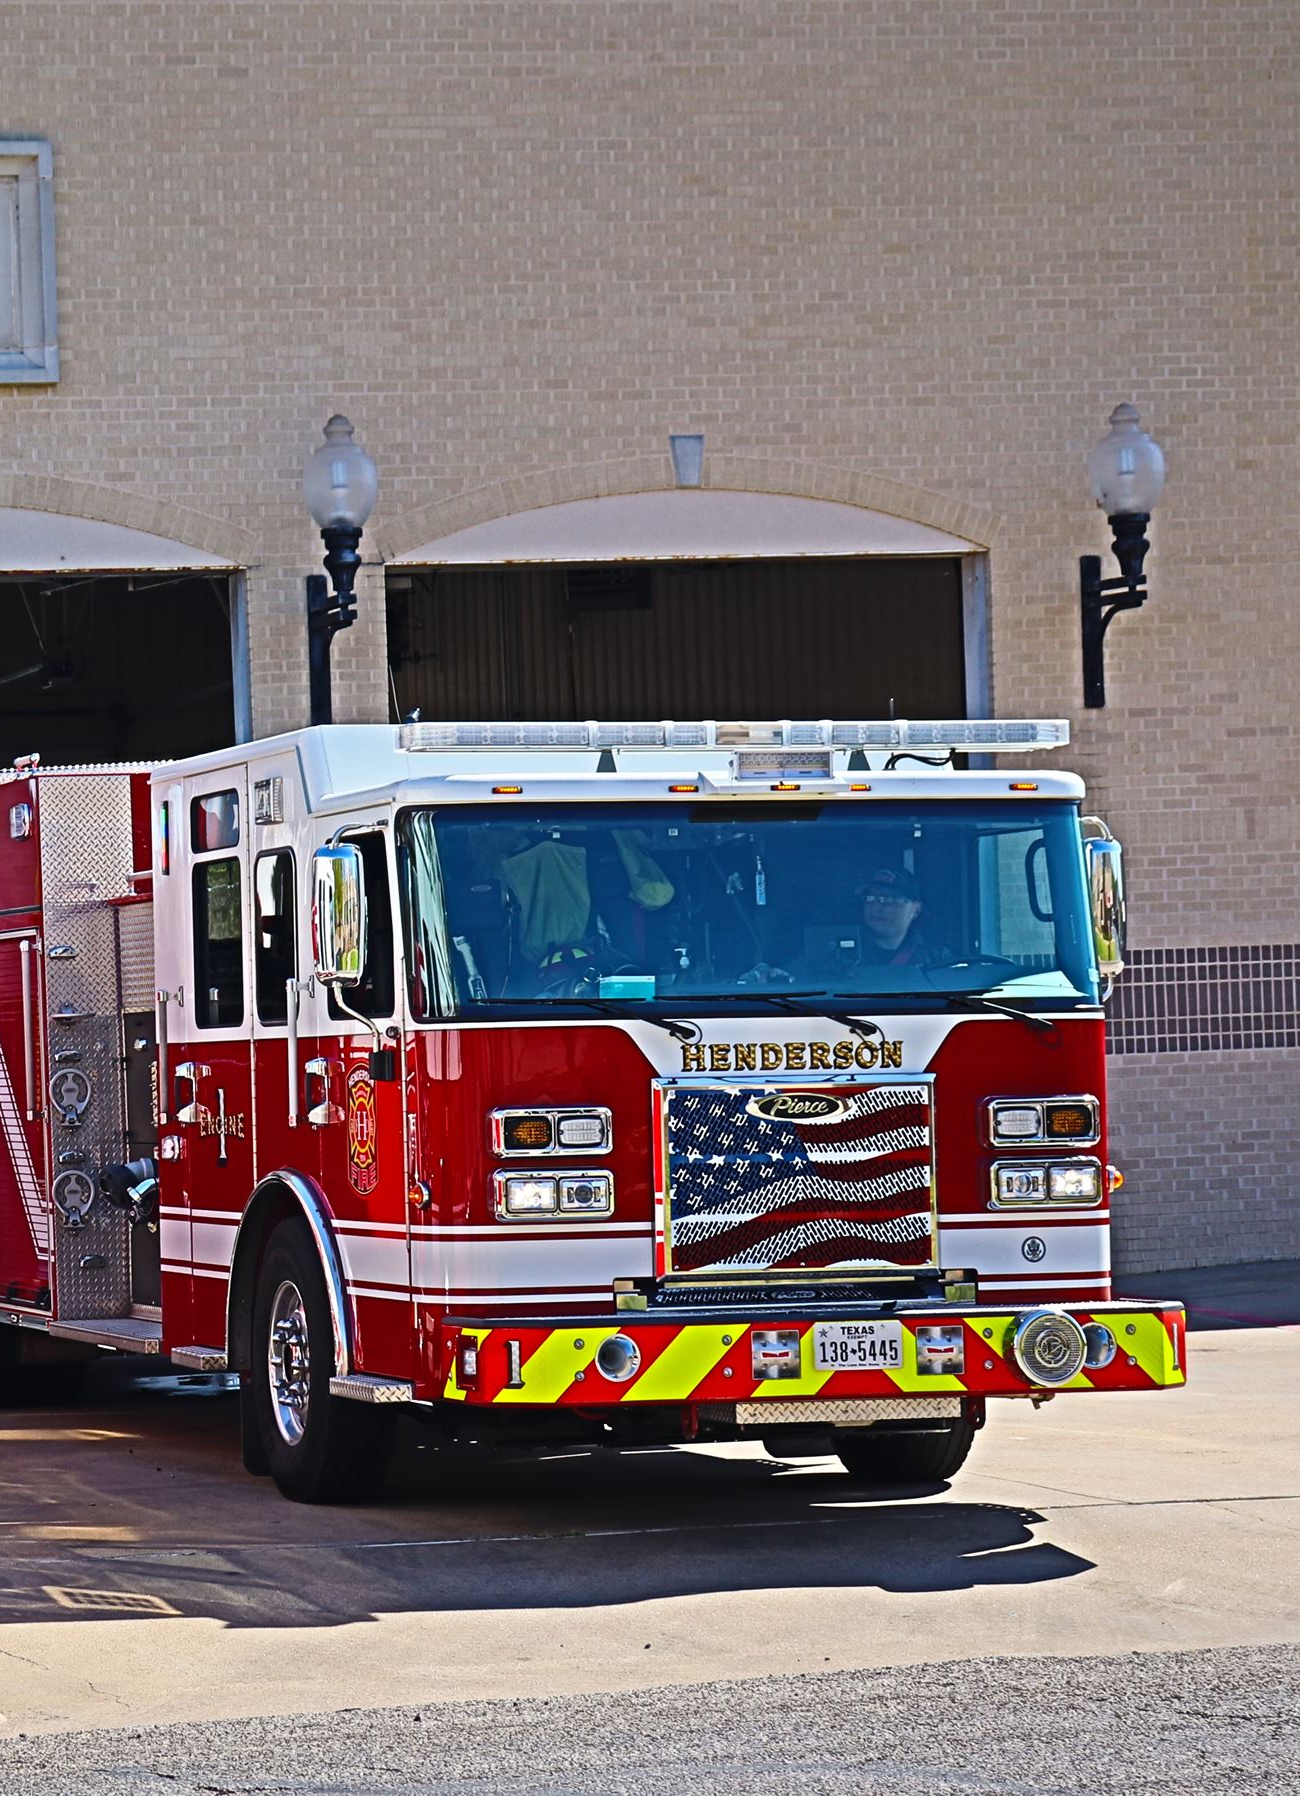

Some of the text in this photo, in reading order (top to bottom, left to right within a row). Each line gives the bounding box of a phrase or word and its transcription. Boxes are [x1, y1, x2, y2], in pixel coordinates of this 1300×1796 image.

[681, 1040, 904, 1073] HENDERSON
[771, 1096, 831, 1116] Pierce
[199, 1112, 245, 1139] ENGINE
[356, 1110, 368, 1141] H
[350, 1161, 377, 1191] FIRE
[840, 1325, 875, 1336] TEXAS
